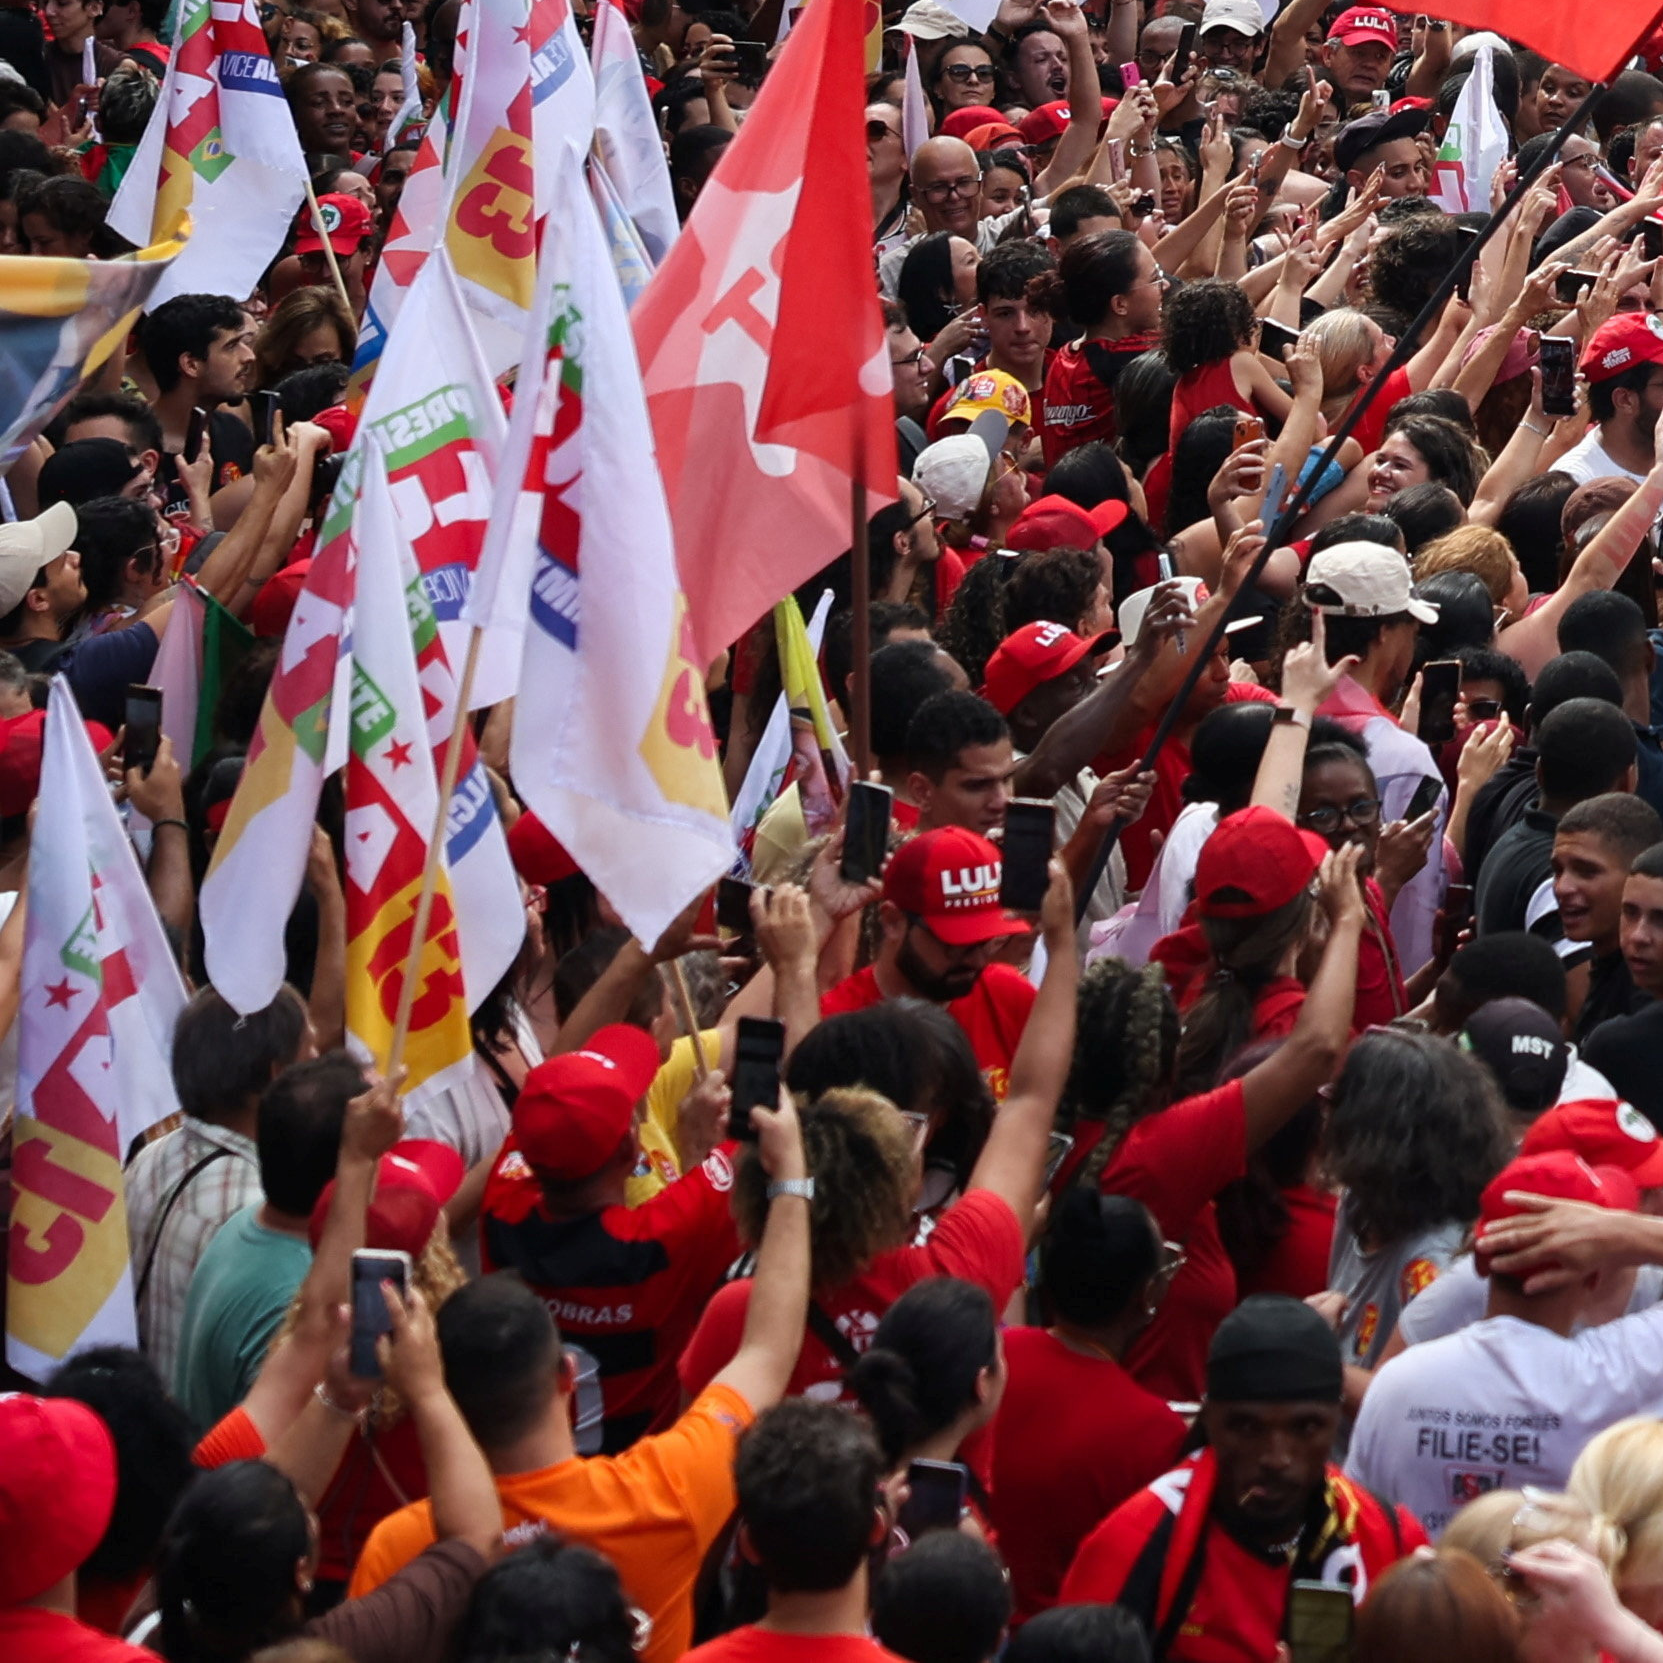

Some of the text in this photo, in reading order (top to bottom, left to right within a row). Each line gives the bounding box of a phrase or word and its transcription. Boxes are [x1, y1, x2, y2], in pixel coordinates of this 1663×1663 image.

[1351, 15, 1391, 33] LULA
[222, 53, 251, 80] VICE
[1511, 1034, 1554, 1060] MST
[1455, 1409, 1498, 1427] SOMOS
[1417, 1428, 1541, 1465] FILIE-SE!
